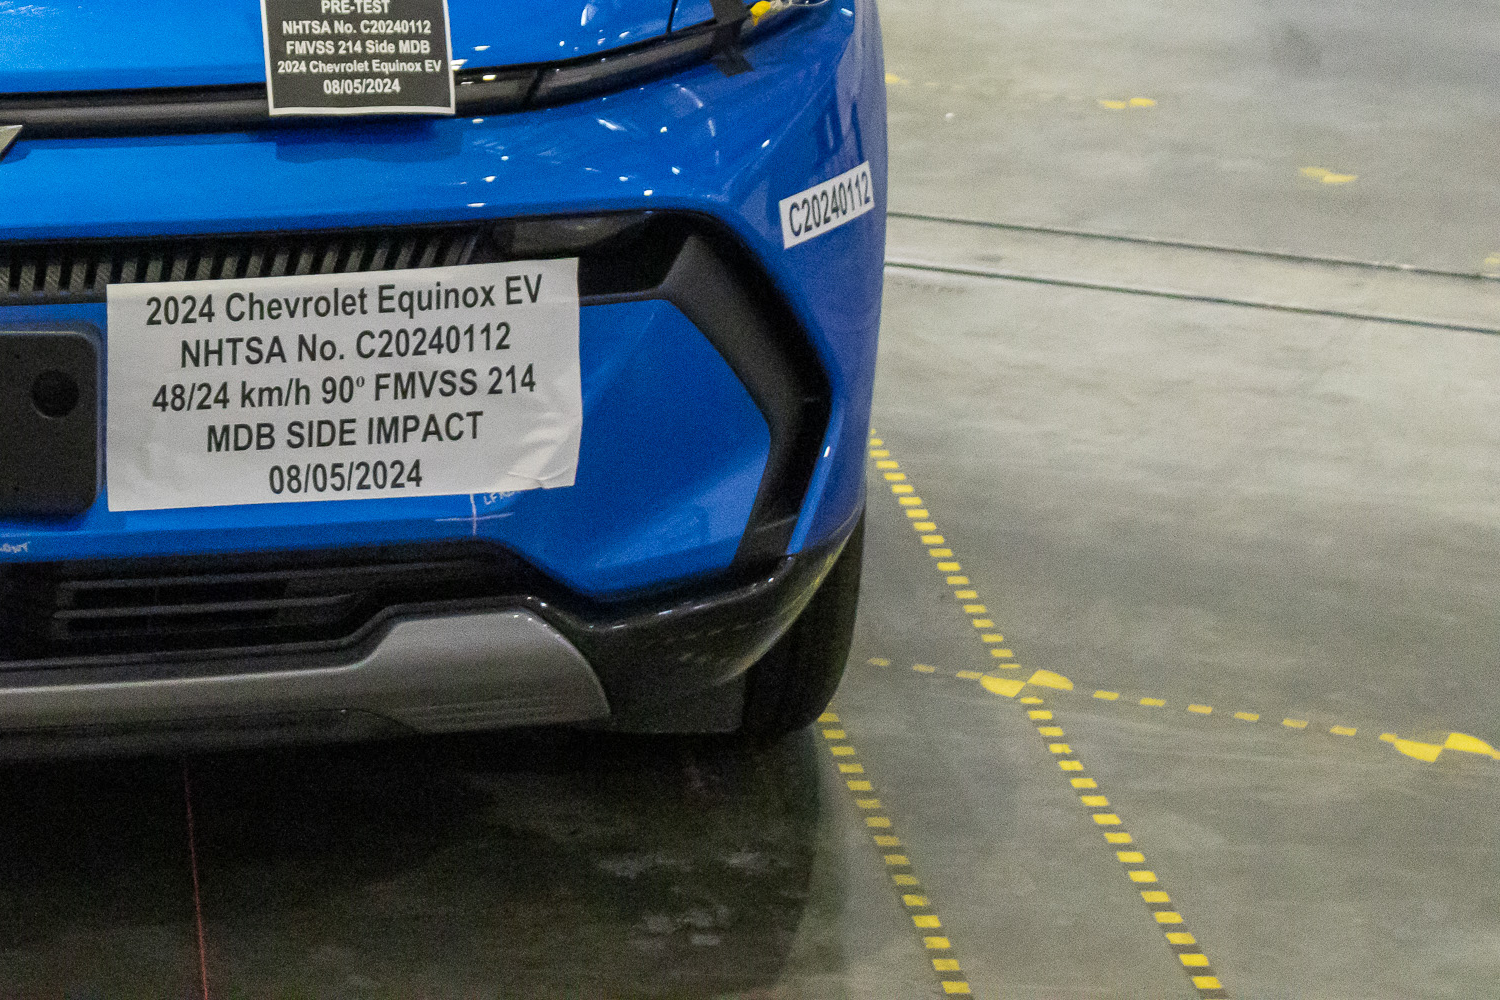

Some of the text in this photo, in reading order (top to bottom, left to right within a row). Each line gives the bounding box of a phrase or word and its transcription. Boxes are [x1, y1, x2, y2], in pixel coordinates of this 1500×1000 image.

[321, 0, 390, 14] PRE-TEST
[282, 20, 431, 35] NHTSA No. C20240112
[286, 39, 431, 55] FMVSS 214 Side MDB
[277, 59, 442, 75] 2024 Chevrolet Equinox EV
[323, 78, 401, 94] 08/05/2024
[788, 170, 871, 236] C20240112
[146, 273, 542, 326] 2024 Chevrolet Equinox EV
[181, 321, 511, 368] NHTSA No. C20240112
[152, 381, 230, 412] 48/24
[240, 377, 311, 408] km/h
[375, 368, 478, 401] FMVSS
[488, 363, 536, 395] 214
[206, 411, 484, 453] MDB SIDE IMPACT
[269, 458, 423, 494] 08/05/2024
